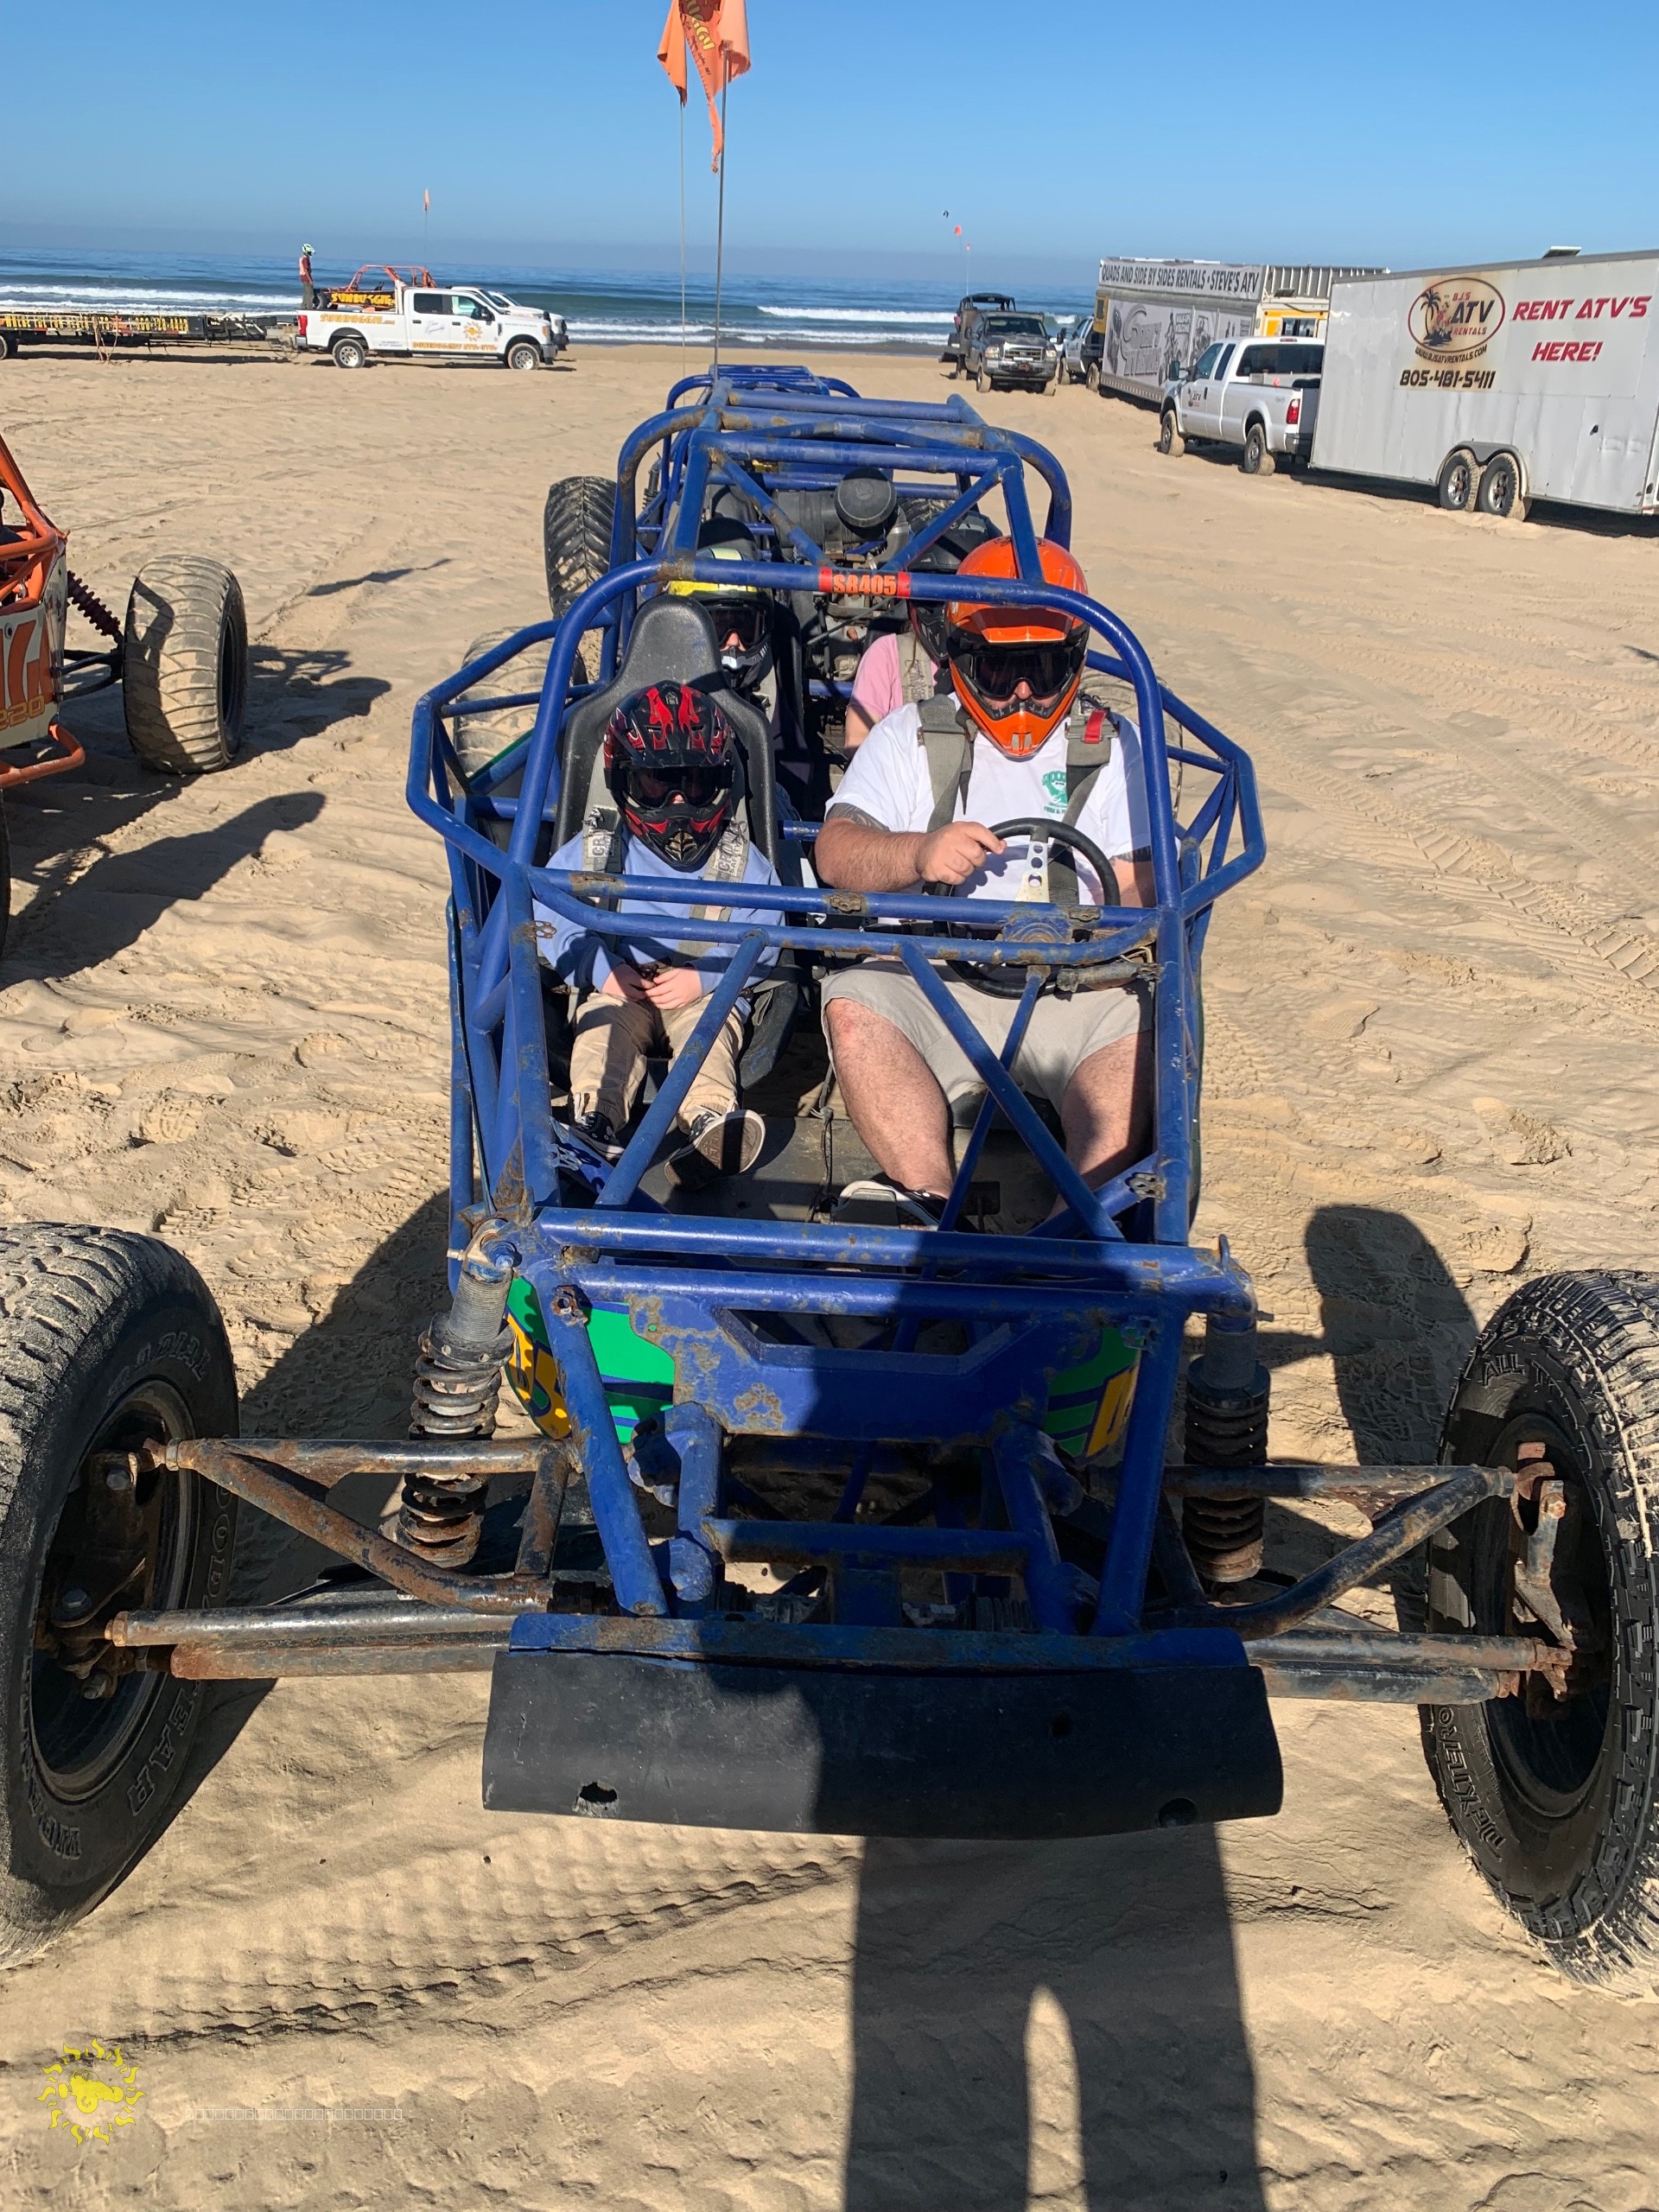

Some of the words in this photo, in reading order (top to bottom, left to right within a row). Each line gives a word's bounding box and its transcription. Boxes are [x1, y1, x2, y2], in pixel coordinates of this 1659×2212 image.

[1102, 264, 1120, 283] QUADS
[1121, 266, 1133, 283] AND
[1134, 267, 1147, 285] SIDE
[1147, 269, 1157, 286] BY
[1157, 269, 1175, 288] SIDES
[1176, 270, 1206, 289] RENTALS
[1211, 270, 1241, 293] STEVE'S
[1241, 272, 1259, 293] ATV
[1451, 300, 1496, 324] ATV
[1512, 299, 1575, 321] RENT
[1575, 296, 1653, 319] ATV'S
[1452, 327, 1487, 335] RENTALS
[1531, 341, 1604, 362] HERE!
[1399, 369, 1496, 389] 805-481-5411
[1483, 1354, 1524, 1389] ALL
